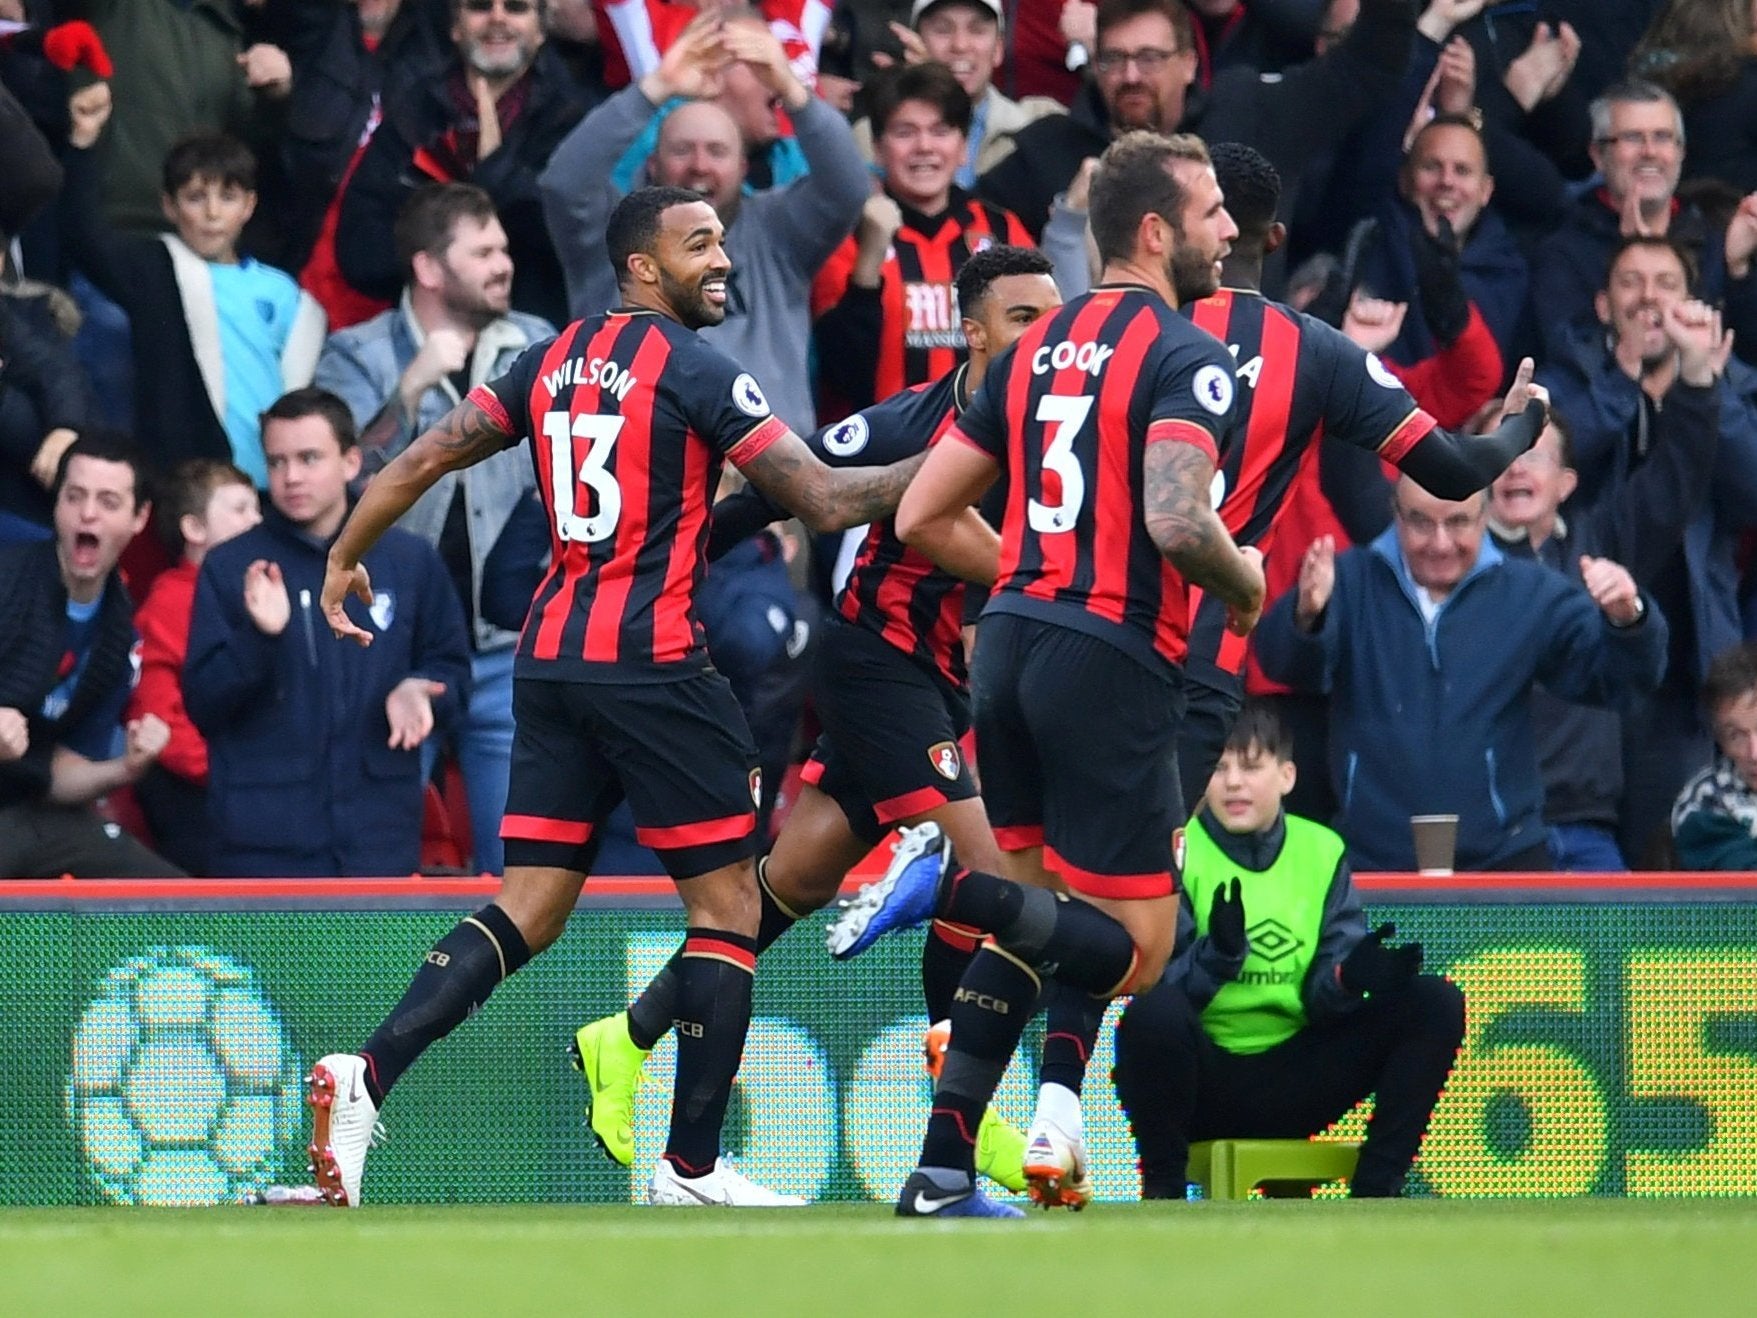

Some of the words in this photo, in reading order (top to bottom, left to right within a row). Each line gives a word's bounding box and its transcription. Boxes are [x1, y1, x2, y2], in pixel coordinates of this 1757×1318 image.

[542, 357, 637, 402] WILSON
[1032, 341, 1113, 377] COOK
[542, 411, 625, 543] 13
[1028, 394, 1095, 533] 3
[953, 987, 1008, 1014] AFCB
